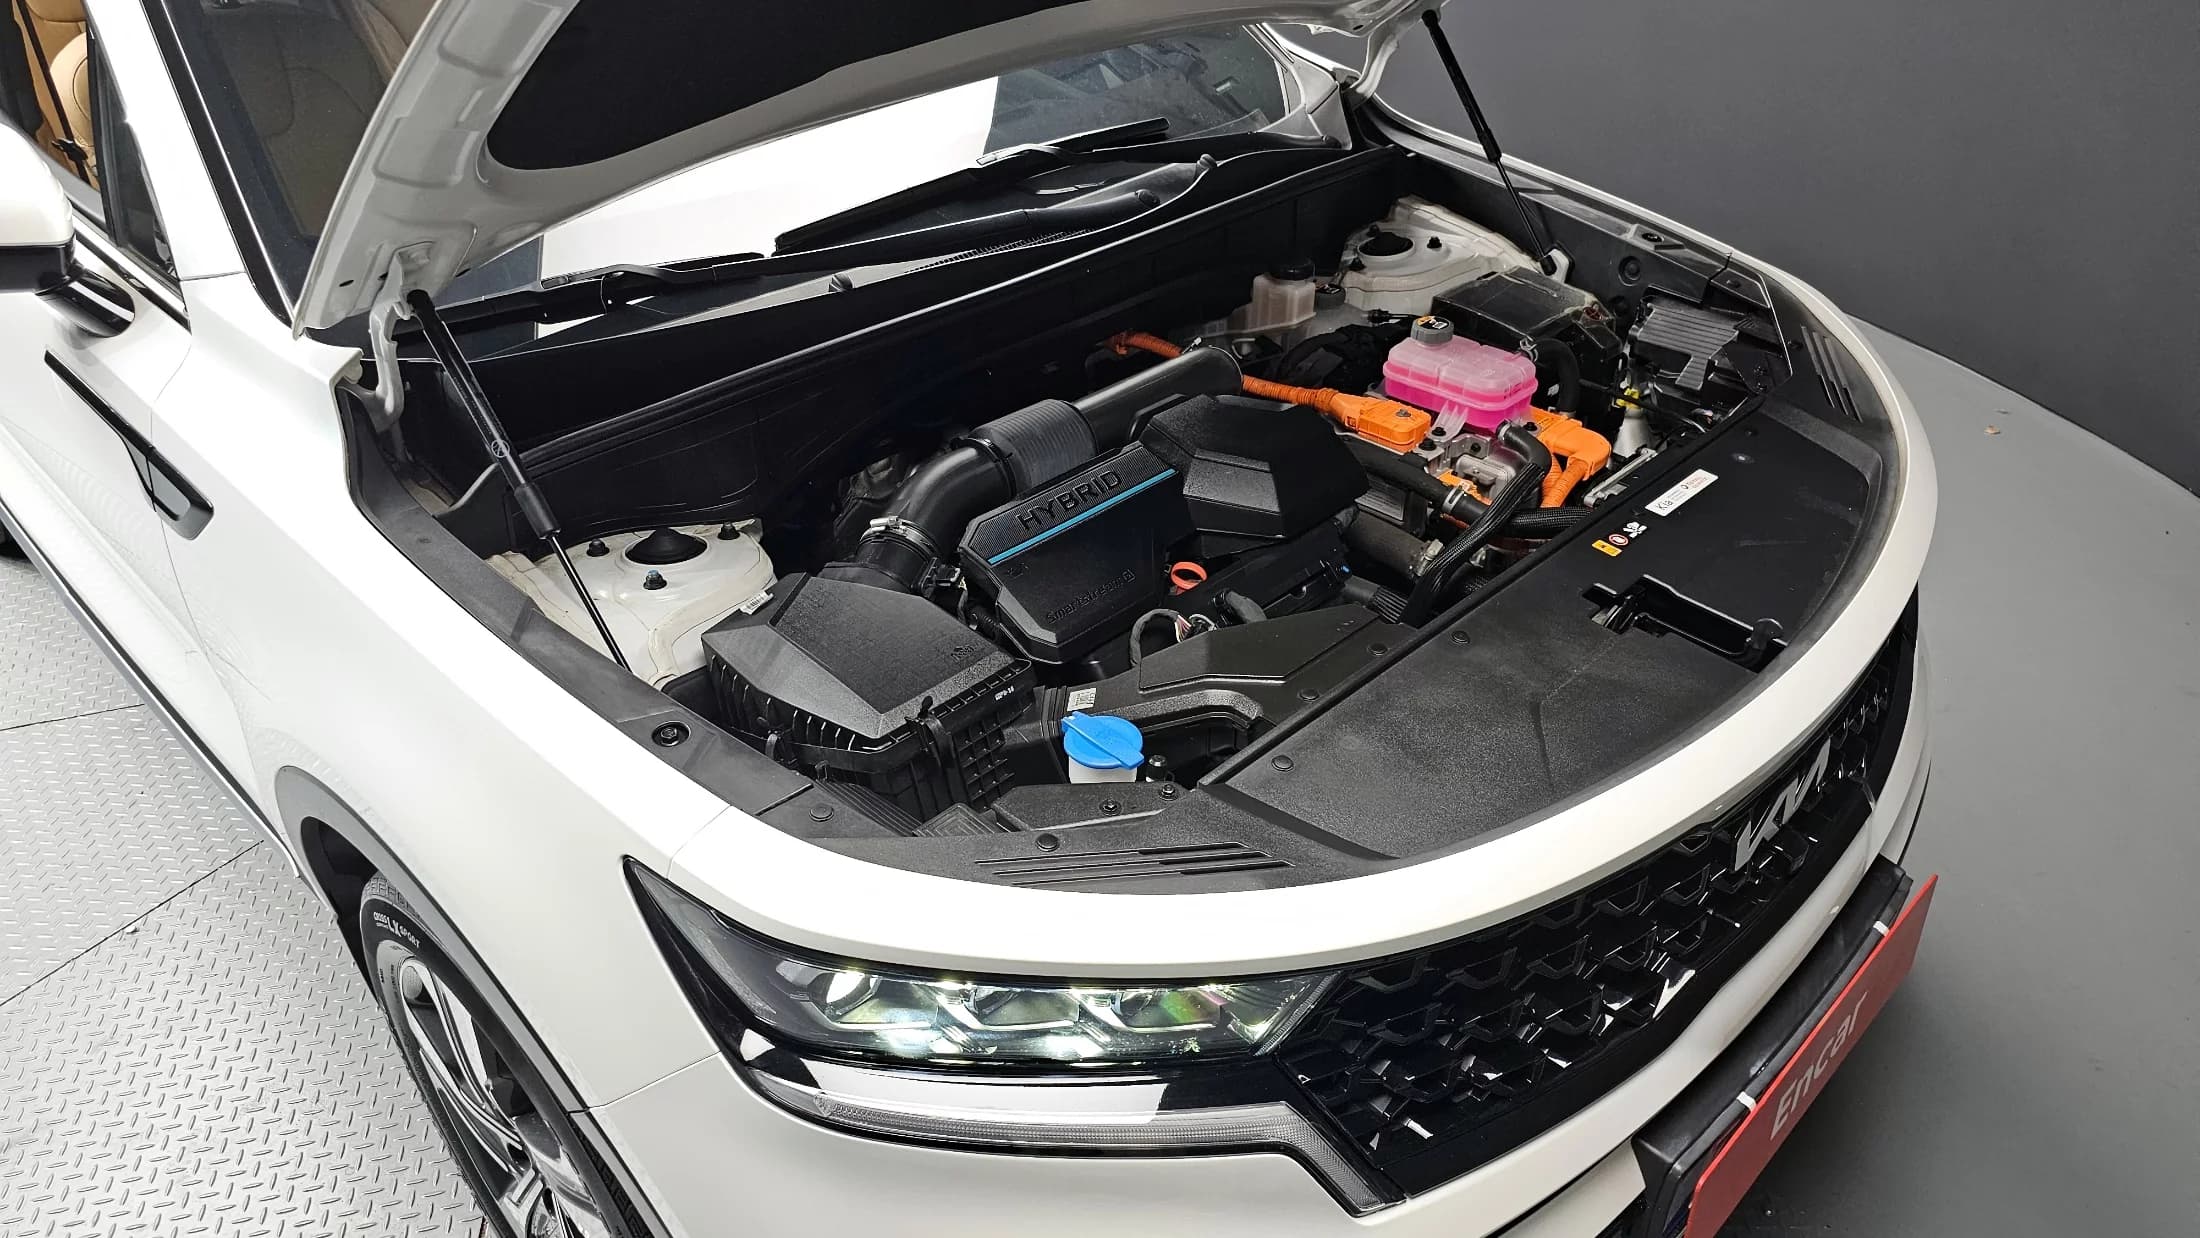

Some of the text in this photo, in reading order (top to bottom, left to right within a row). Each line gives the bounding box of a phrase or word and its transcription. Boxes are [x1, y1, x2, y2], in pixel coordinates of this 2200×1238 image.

[1015, 470, 1121, 531] HYBRID
[386, 917, 402, 937] LX
[399, 925, 420, 949] SPORT
[1769, 991, 1868, 1141] Encar
